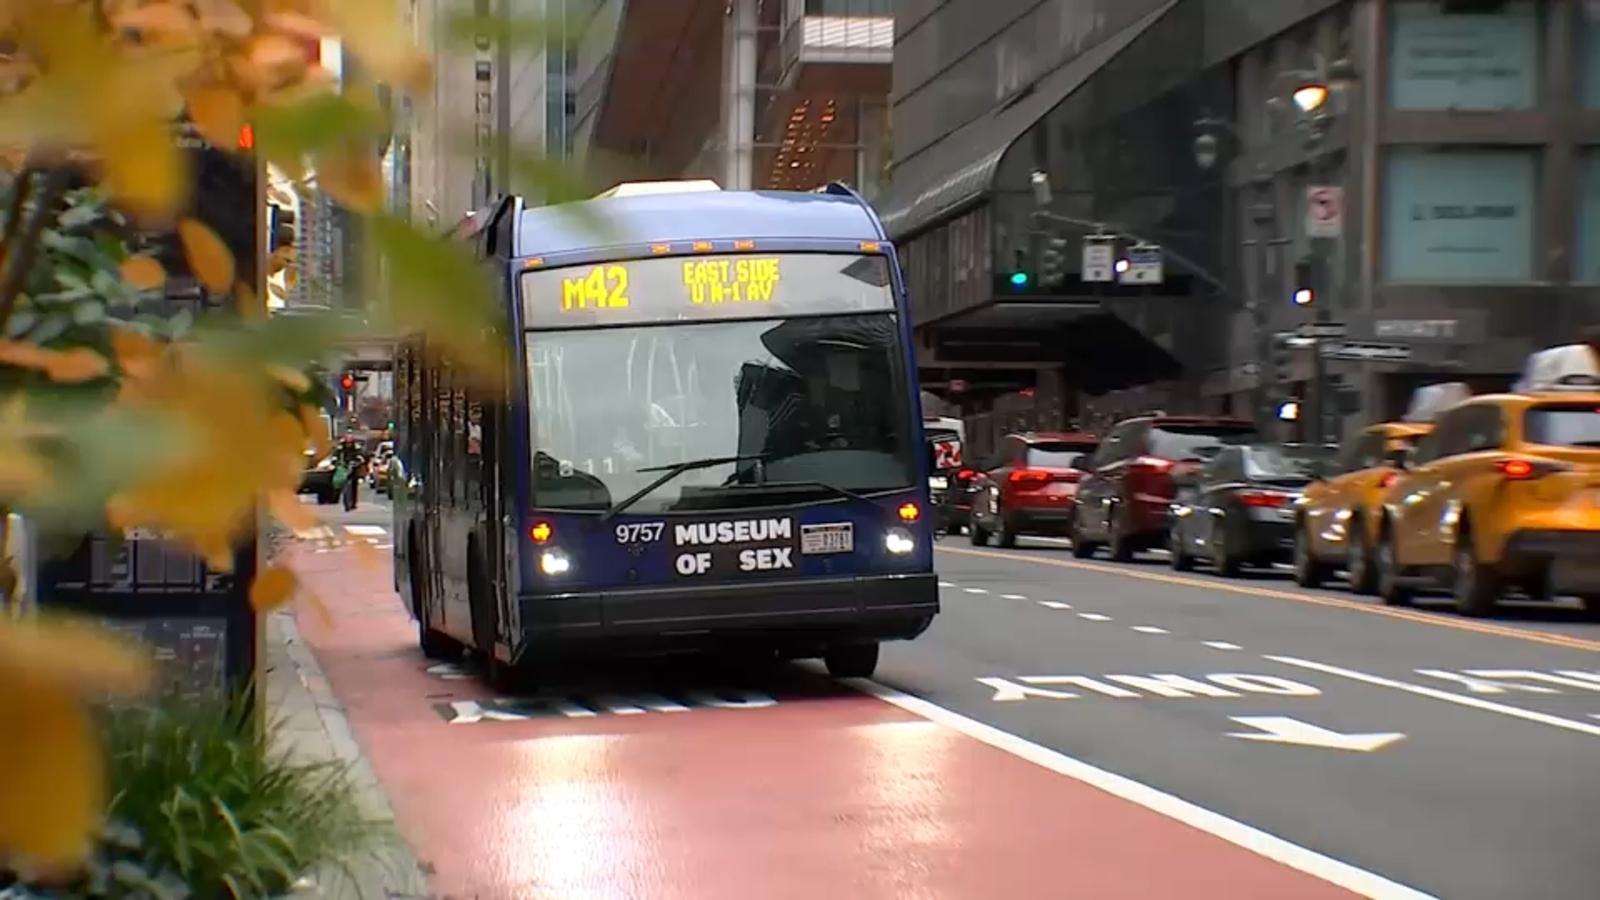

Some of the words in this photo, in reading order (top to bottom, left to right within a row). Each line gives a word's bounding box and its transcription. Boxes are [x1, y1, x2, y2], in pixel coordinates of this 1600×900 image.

[682, 259, 730, 284] EAST
[735, 257, 780, 282] SIDE
[562, 265, 630, 311] M42
[690, 283, 706, 304] U
[746, 280, 774, 301] AV
[615, 522, 665, 543] 9757
[675, 517, 792, 545] MUSEUM
[676, 552, 711, 575] OF
[739, 547, 793, 571] SEX
[975, 673, 1323, 702] ONLY
